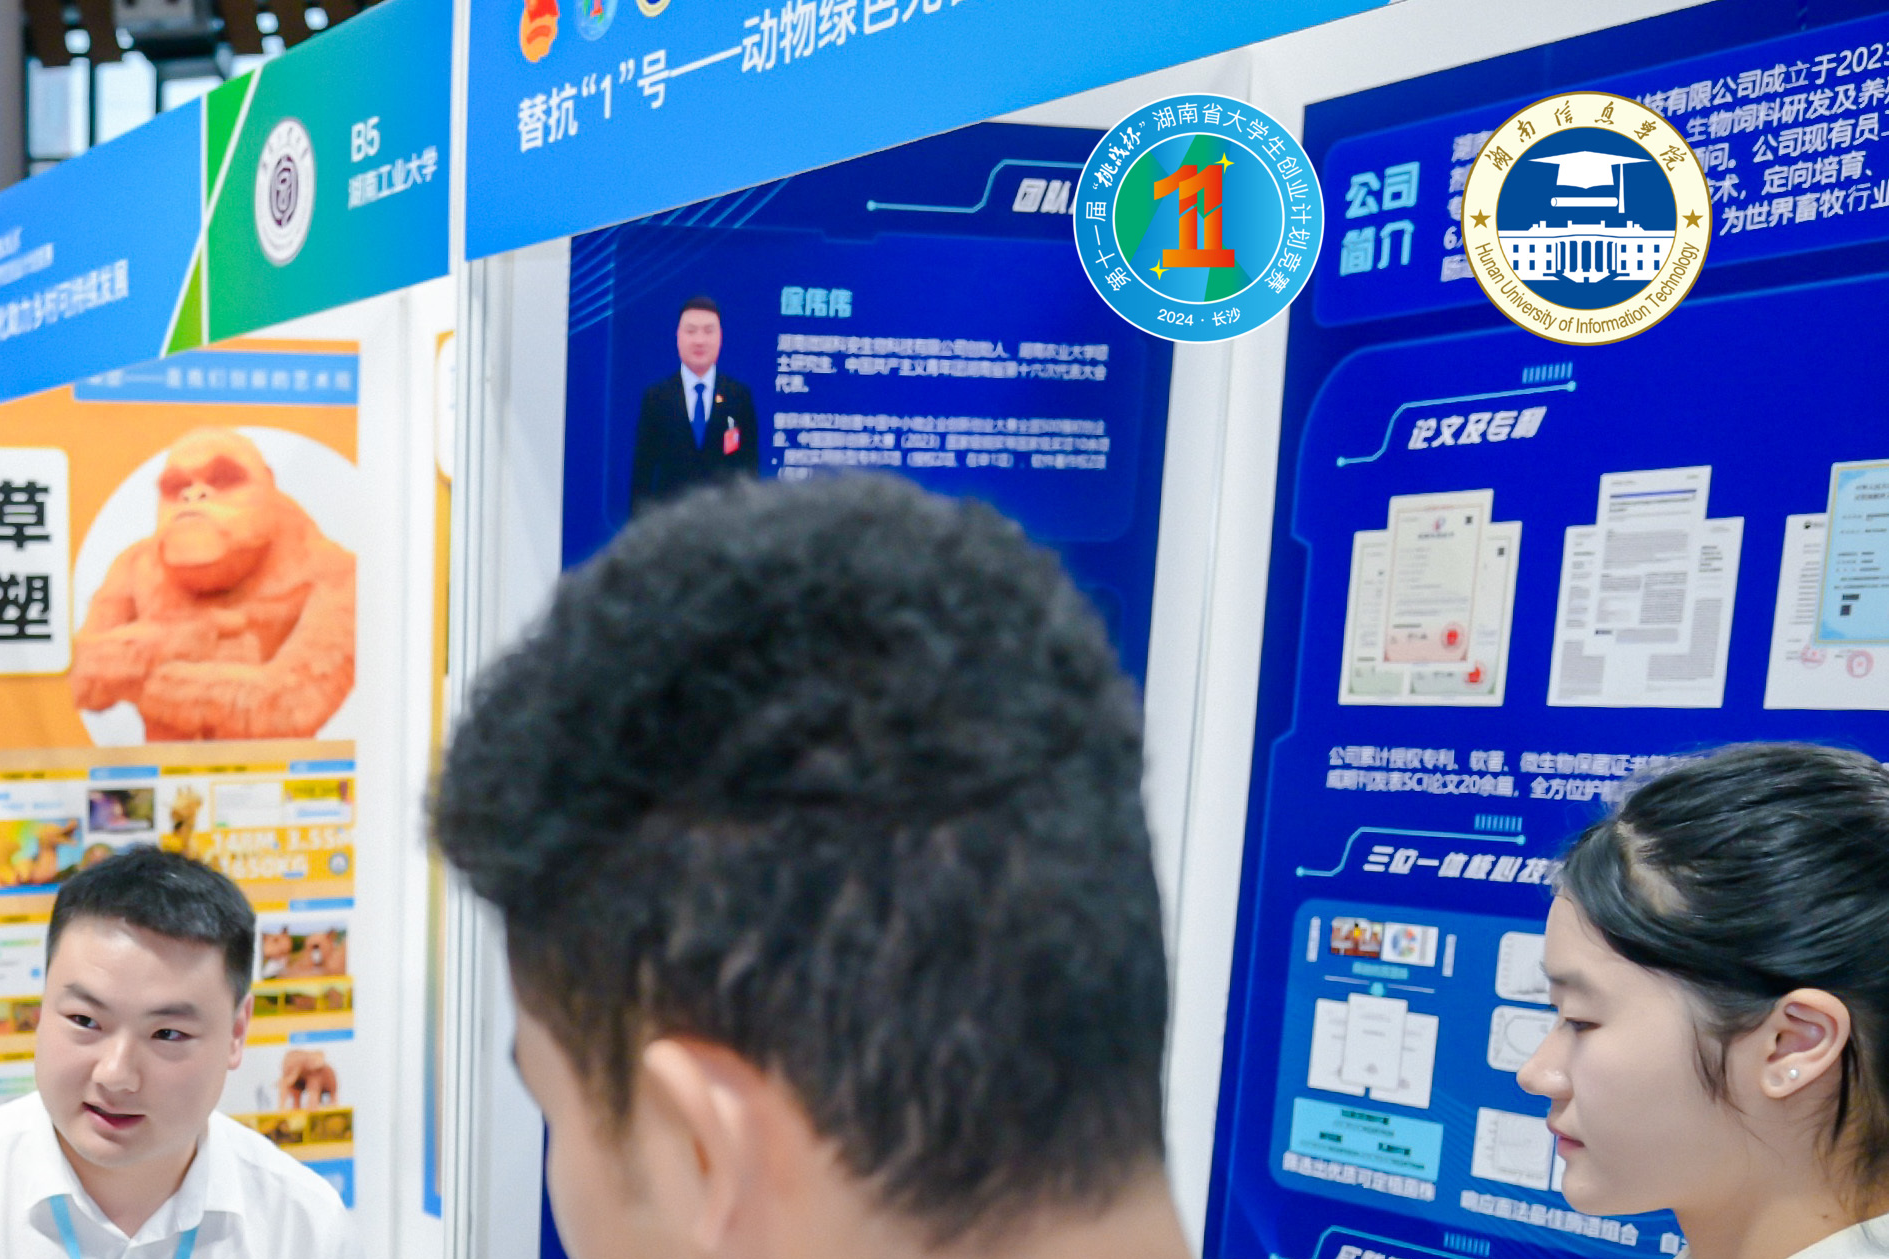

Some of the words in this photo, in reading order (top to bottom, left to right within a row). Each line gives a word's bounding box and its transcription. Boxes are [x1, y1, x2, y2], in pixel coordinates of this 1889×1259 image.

[517, 0, 971, 153] 替抗“1”号——动物绿色
[1636, 42, 1889, 118] 技有限公司成立于202
[1686, 76, 1889, 142] 生物饲料研发及养
[351, 116, 380, 163] B5
[348, 145, 438, 210] 湖南工业大学
[1013, 178, 1078, 214] 团队
[1345, 161, 1421, 220] 公司
[1340, 219, 1415, 277] 简介
[1408, 406, 1548, 450] 论文及专利
